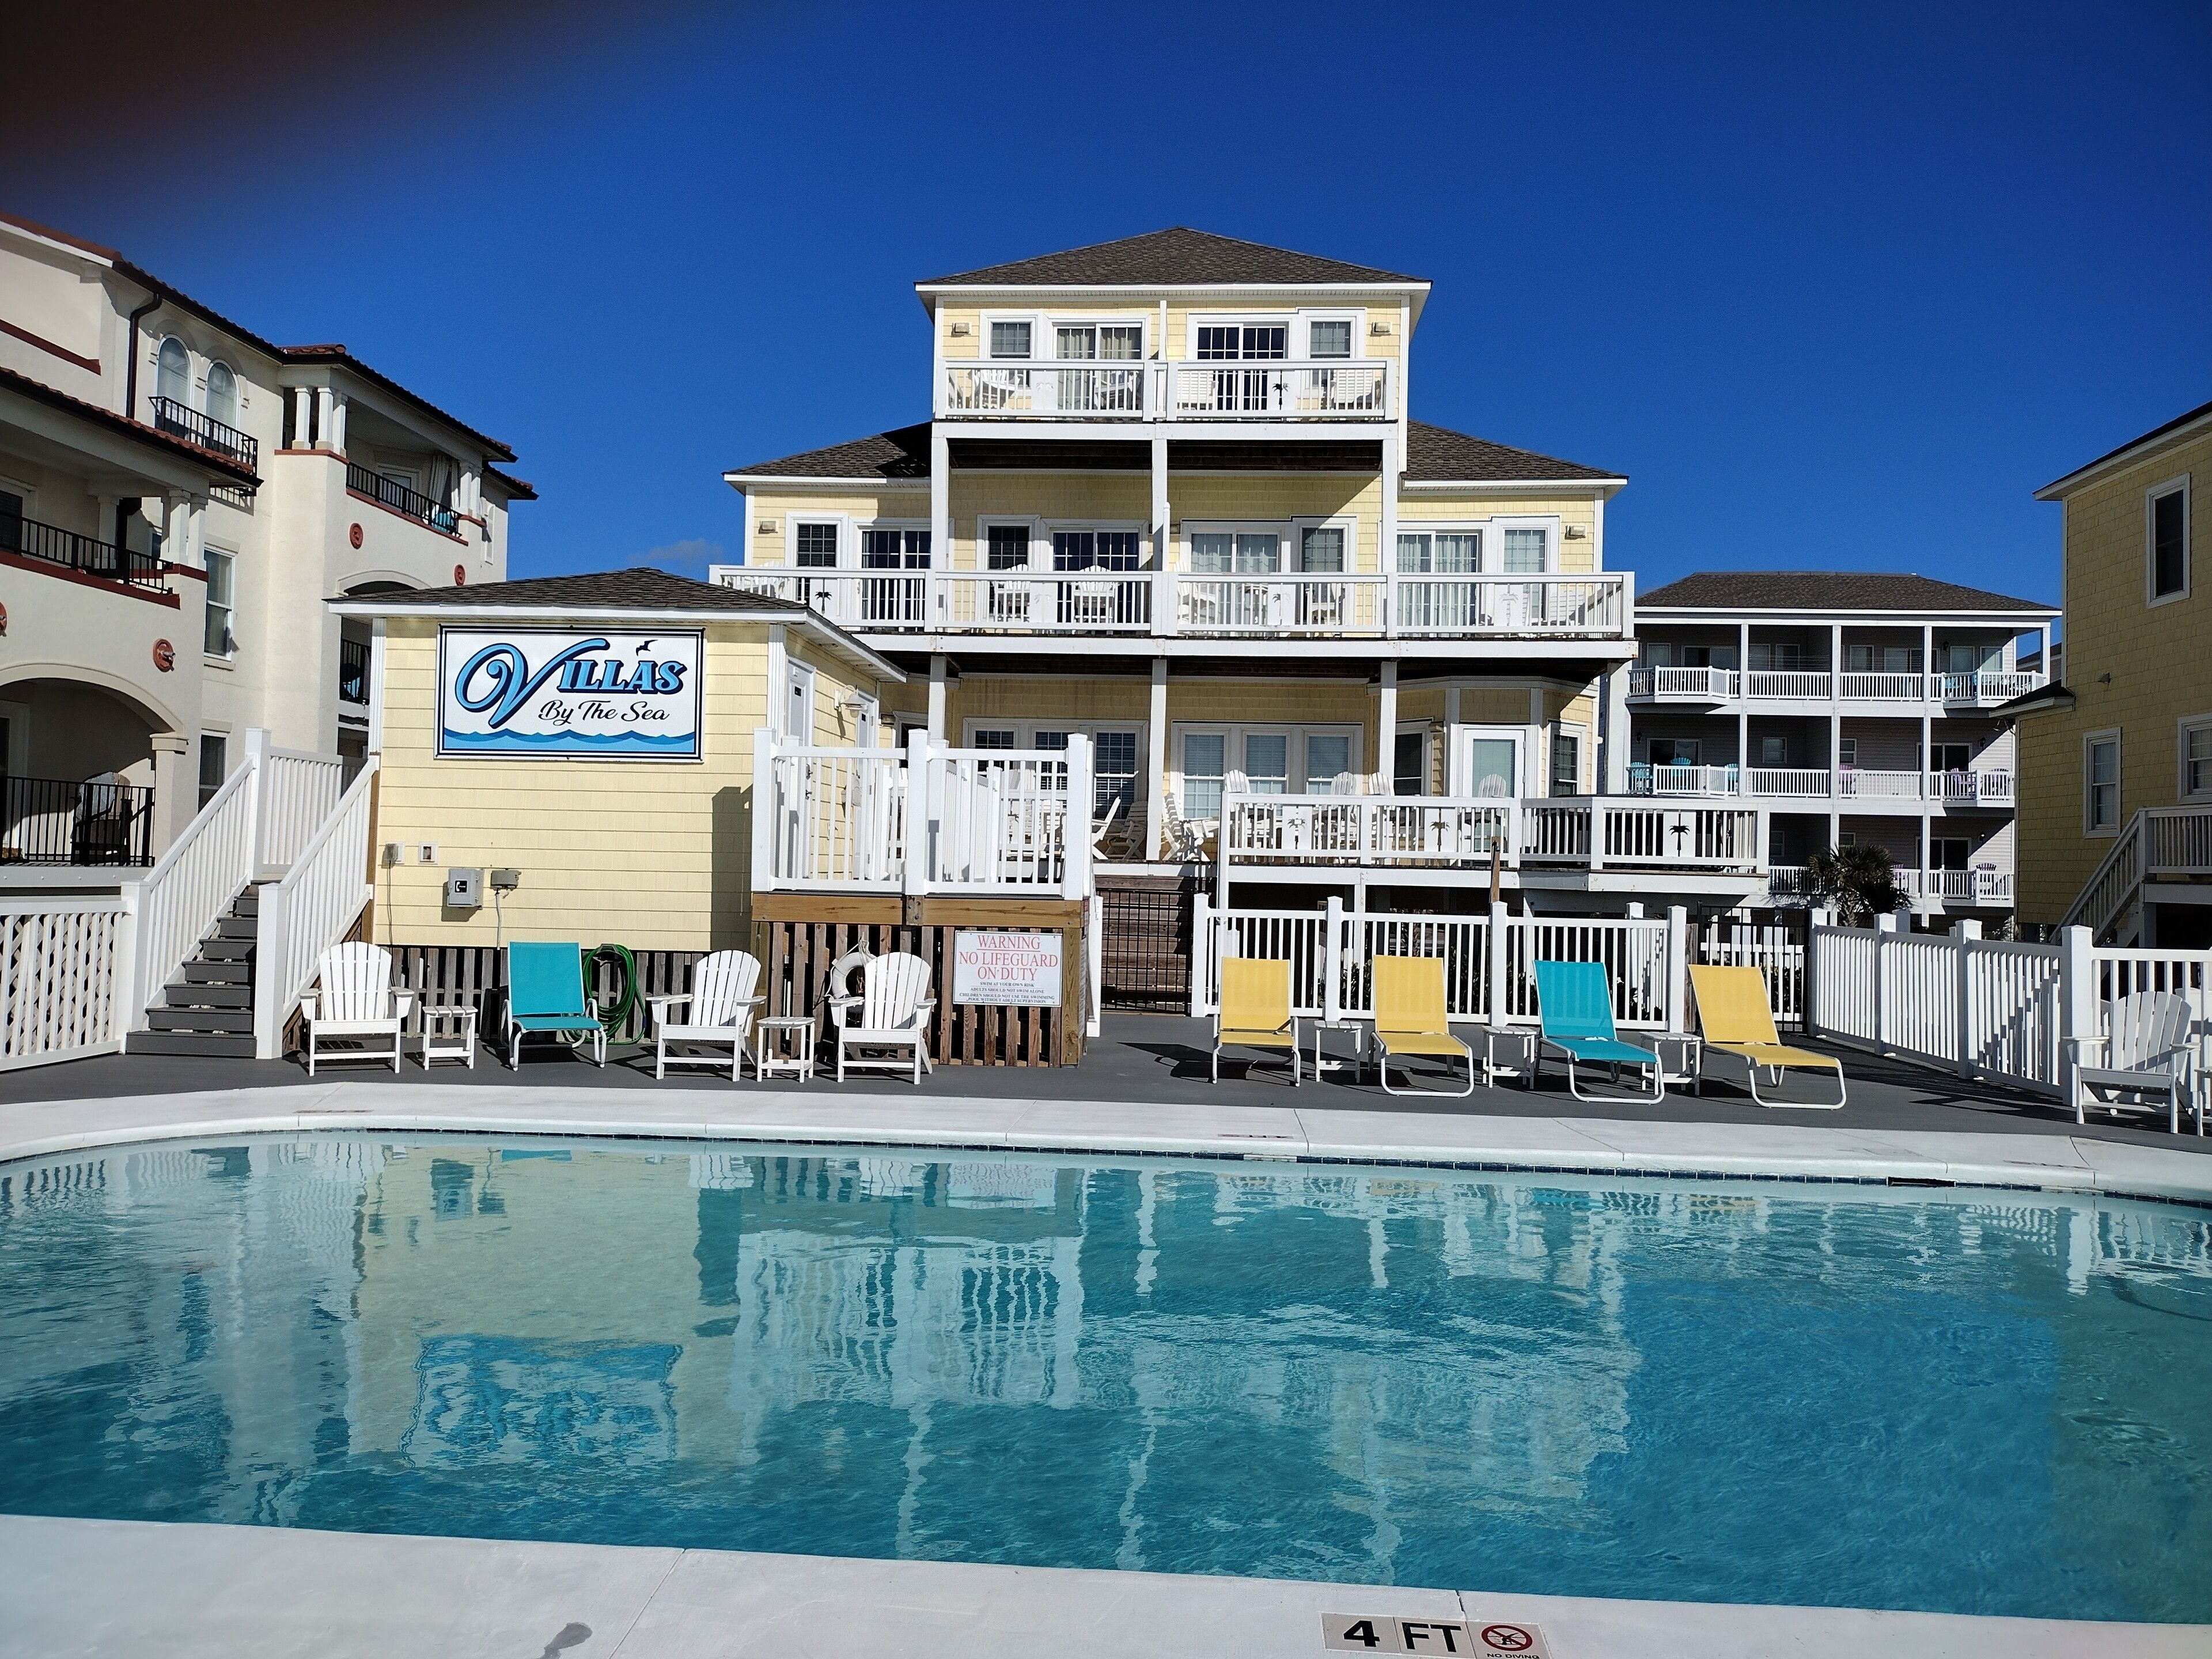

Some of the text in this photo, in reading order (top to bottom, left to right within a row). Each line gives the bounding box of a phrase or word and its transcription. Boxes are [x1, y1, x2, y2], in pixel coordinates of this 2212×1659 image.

[455, 638, 687, 729] VILLAS
[538, 699, 670, 726] By The Sea
[978, 935, 1040, 949] WARNING
[959, 951, 1058, 967] NO LIFEGUARD
[978, 966, 1037, 980] ON DUTY
[1343, 1620, 1462, 1653] 4 FT
